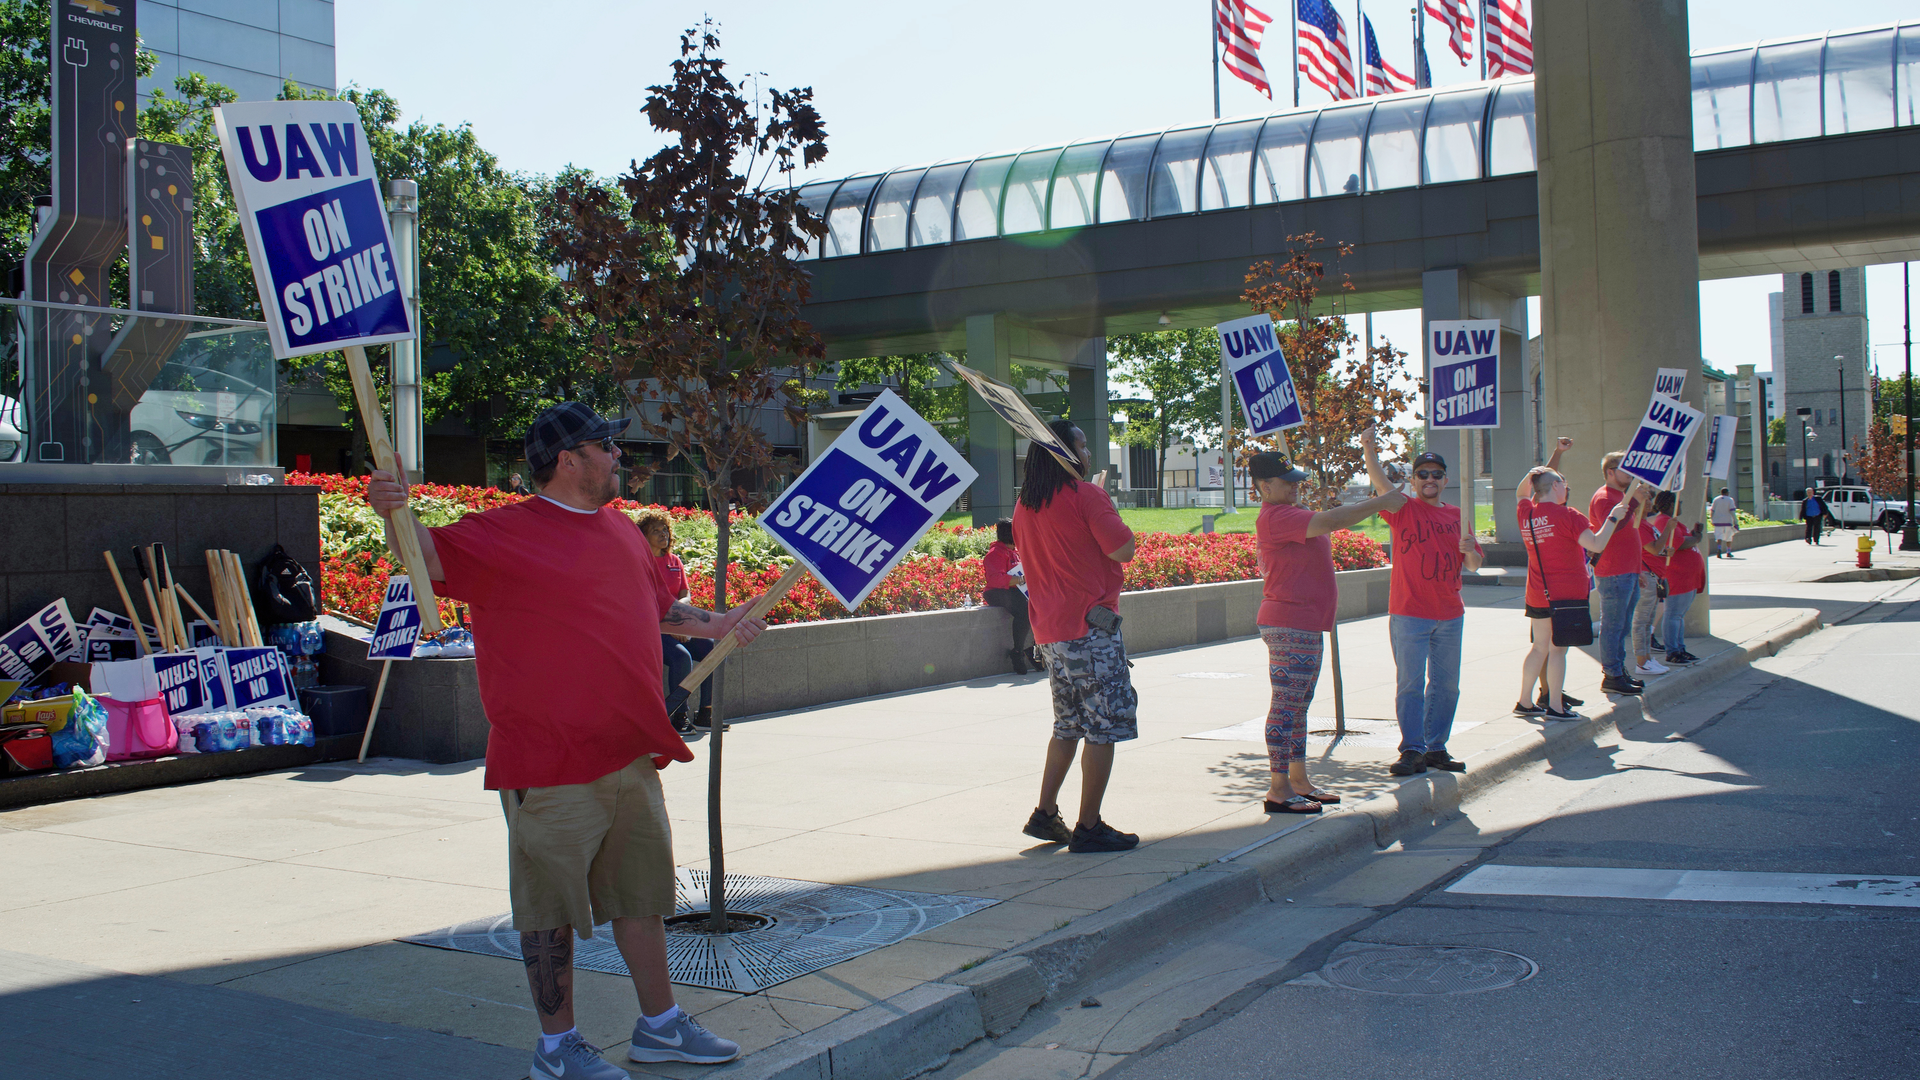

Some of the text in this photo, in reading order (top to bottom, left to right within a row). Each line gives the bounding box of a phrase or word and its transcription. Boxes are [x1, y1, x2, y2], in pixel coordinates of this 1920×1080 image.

[68, 14, 124, 32] CHEVROLET
[236, 122, 360, 183] UAW
[303, 199, 351, 262] ON
[284, 242, 396, 337] STRIKE
[1223, 324, 1275, 359] UAW
[1434, 329, 1496, 355] UAW
[1253, 369, 1276, 393] ON
[1453, 363, 1477, 392] ON
[1656, 375, 1684, 394] UAW
[1249, 383, 1295, 428] STRIKE
[1436, 384, 1495, 422] STRIKE
[1649, 401, 1694, 433] UAW
[858, 405, 961, 503] UAW
[1645, 433, 1668, 452] ON
[1624, 450, 1673, 472] STRIKE
[839, 478, 897, 524] ON
[775, 494, 894, 576] STRIKE
[40, 604, 74, 656] UAW
[389, 608, 410, 630] ON
[19, 640, 46, 664] ON
[372, 625, 417, 654] STRIKE
[158, 658, 198, 690] STRIK
[230, 651, 276, 684] STRIKE
[169, 686, 188, 712] ON
[248, 676, 269, 700] ON
[38, 710, 56, 722] Lay's
